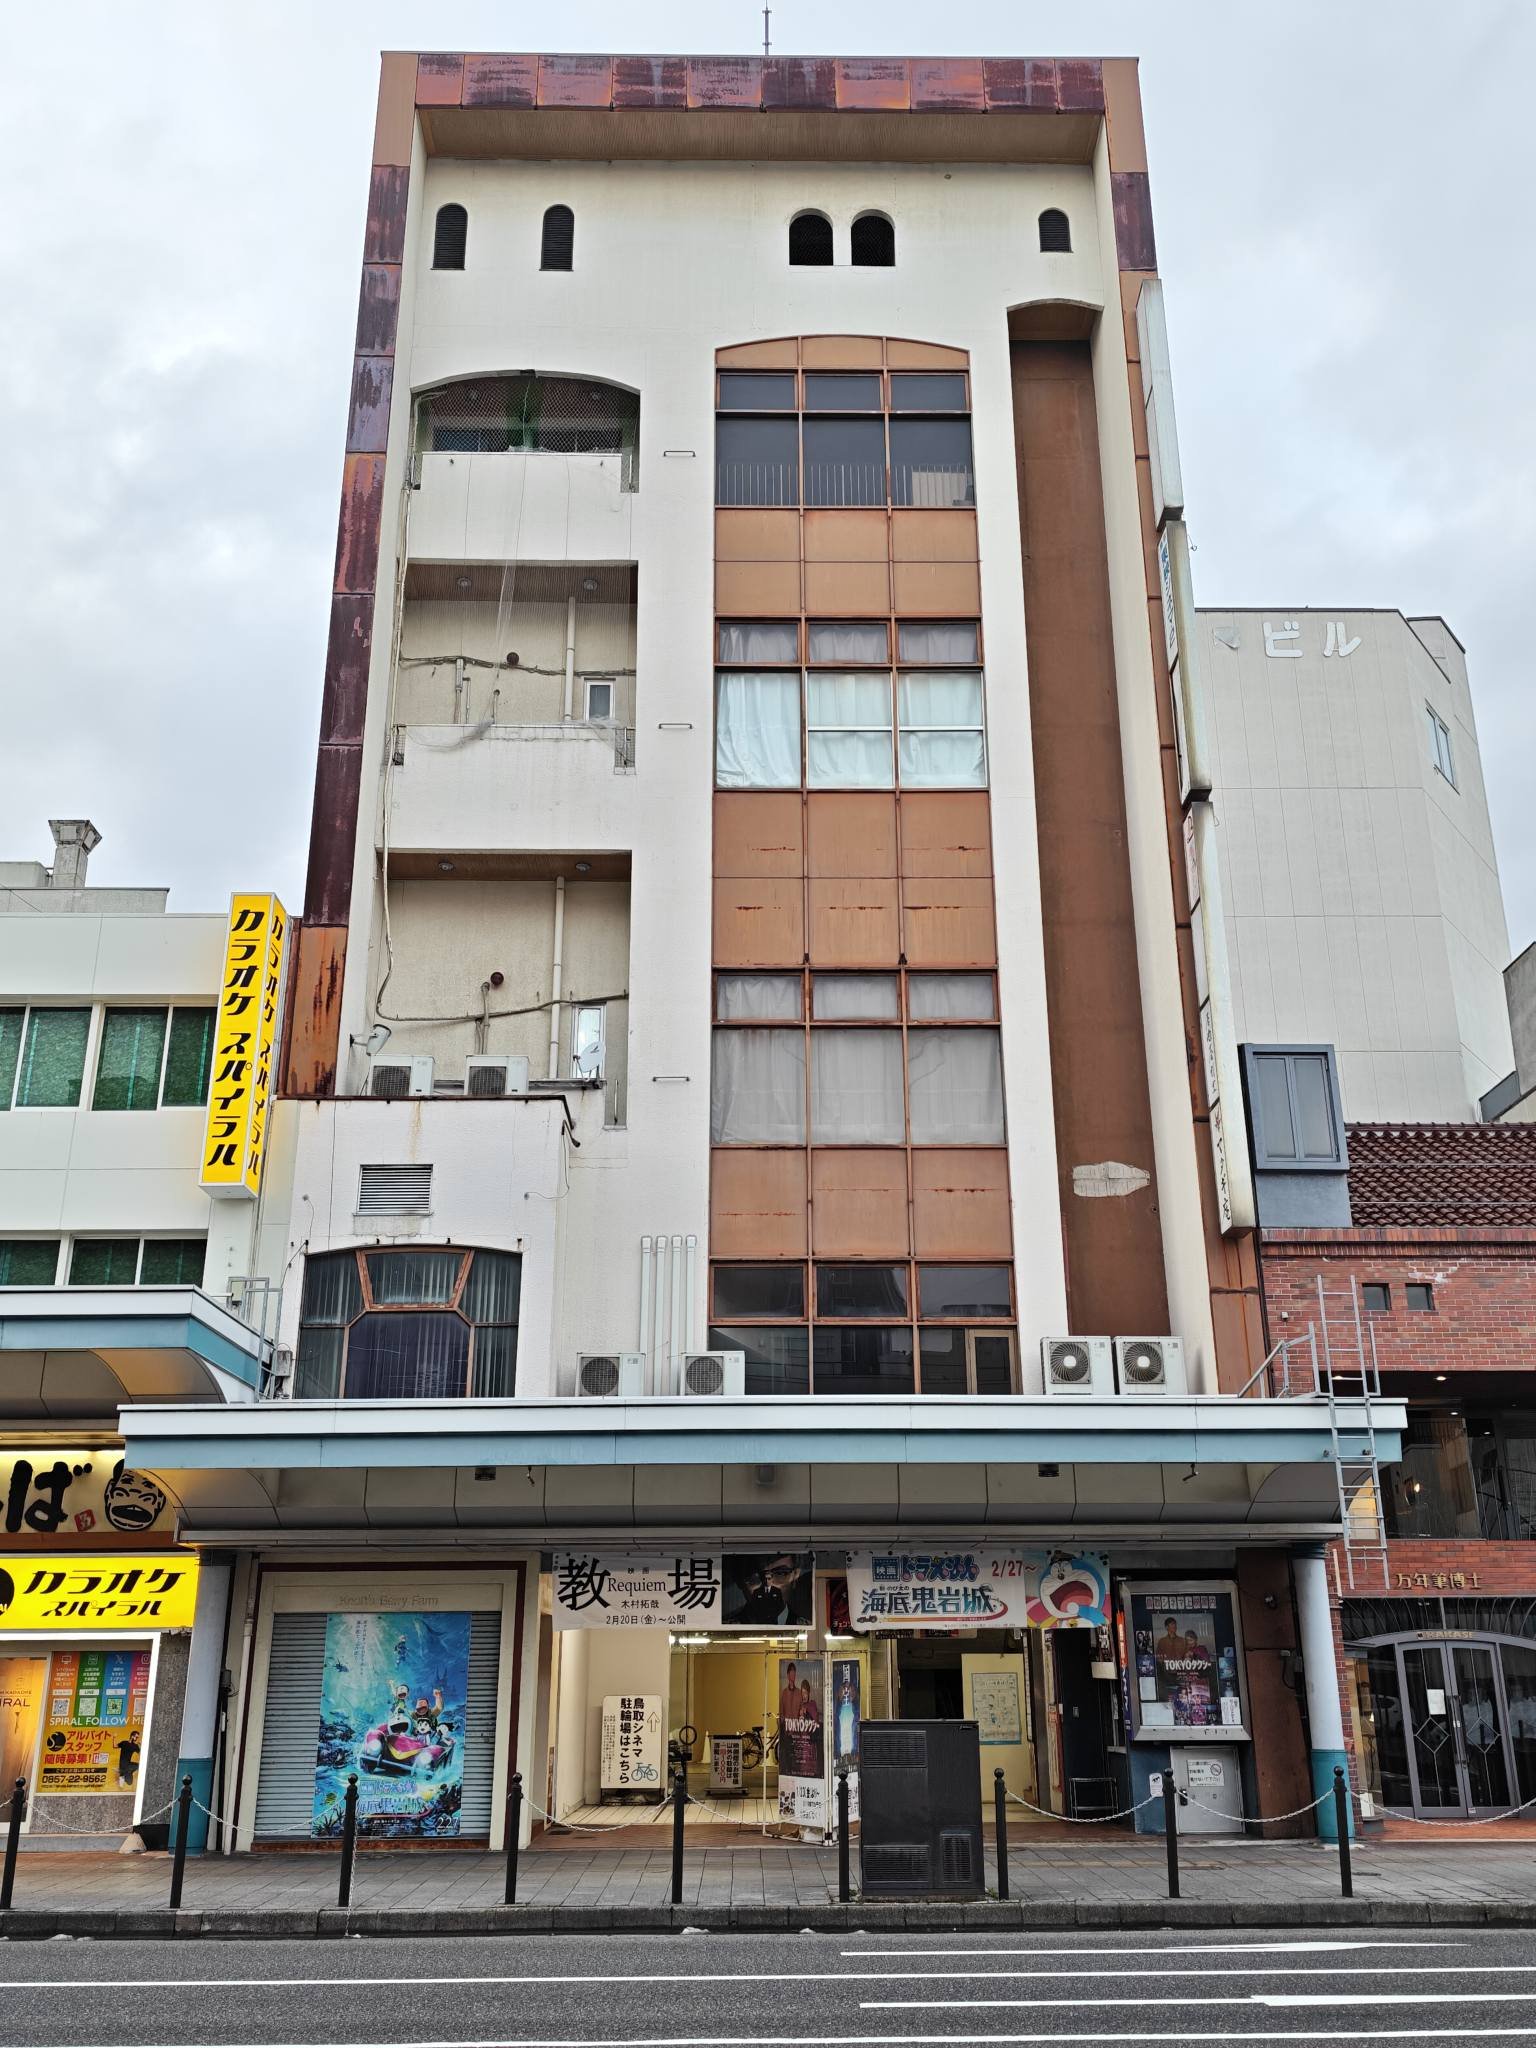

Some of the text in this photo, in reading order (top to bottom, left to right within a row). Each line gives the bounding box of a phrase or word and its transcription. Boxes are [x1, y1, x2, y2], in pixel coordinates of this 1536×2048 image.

[1262, 621, 1361, 658] ビル
[207, 909, 265, 1166] カラオケ スパイラル
[247, 915, 283, 1176] カラオケ スパイラル
[876, 1566, 897, 1575] 映画
[901, 1555, 980, 1582] ドラえもん
[23, 1569, 186, 1594] カラオケ
[557, 1558, 720, 1611] 教 場
[607, 1578, 666, 1597] Requiem
[1396, 1572, 1483, 1589] 万年筆博士
[41, 1600, 163, 1616] スパイラル
[621, 1600, 660, 1609] 木村拓哉
[861, 1586, 999, 1614] 海底鬼岩城
[1164, 1659, 1212, 1671] TOKYOタクシー
[50, 1717, 82, 1726] SPIRAL
[85, 1716, 129, 1726] FOLLOW
[632, 1698, 645, 1758] 鳥取シネマ
[785, 1716, 820, 1733] TOKYOタクシー
[67, 1730, 111, 1740] アルバイト
[619, 1698, 633, 1784] 駐輪場はこちら
[65, 1742, 103, 1752] スタッフ
